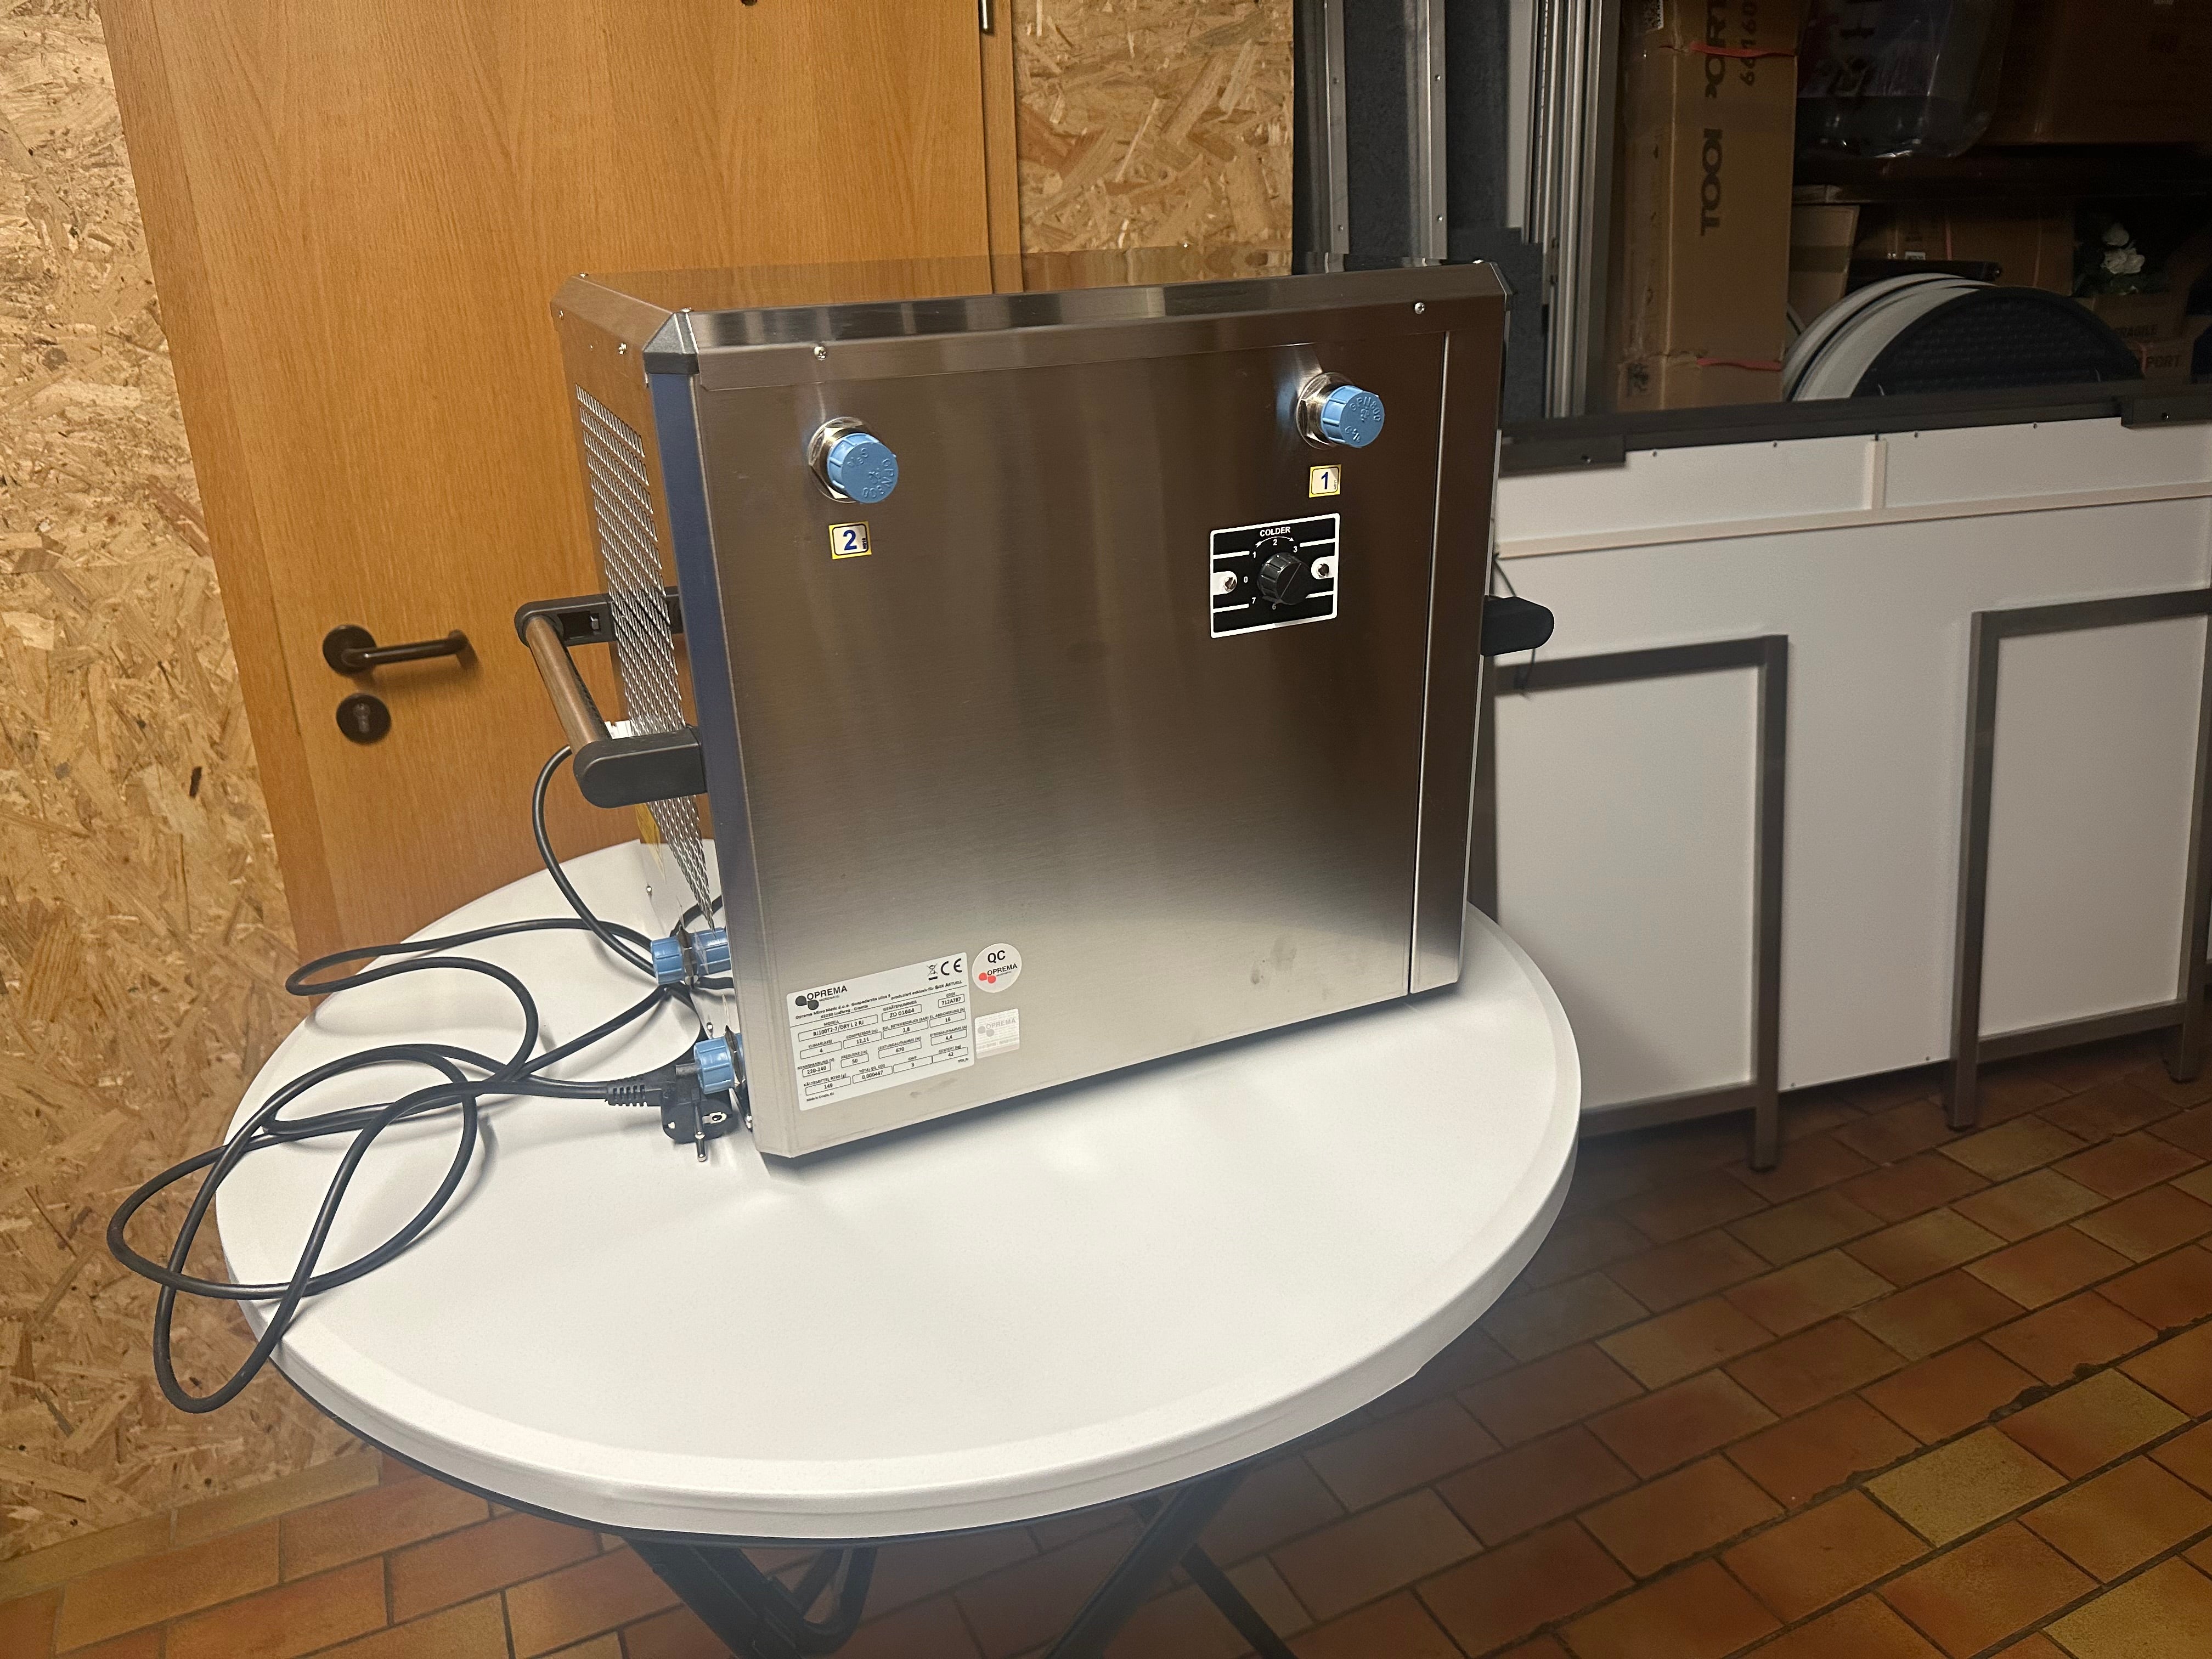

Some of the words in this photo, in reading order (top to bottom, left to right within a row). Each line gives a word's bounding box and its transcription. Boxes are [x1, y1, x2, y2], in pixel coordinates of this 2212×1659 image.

[1321, 471, 1329, 490] 1
[1260, 526, 1291, 537] COLDER
[843, 529, 857, 551] 2
[987, 950, 1006, 963] QC
[987, 963, 1018, 976] OPREMA
[806, 985, 847, 1001] OPREMA
[986, 1018, 1016, 1029] OPREMA
[807, 1065, 826, 1074] 220-240
[862, 1070, 883, 1080] 0,000447
